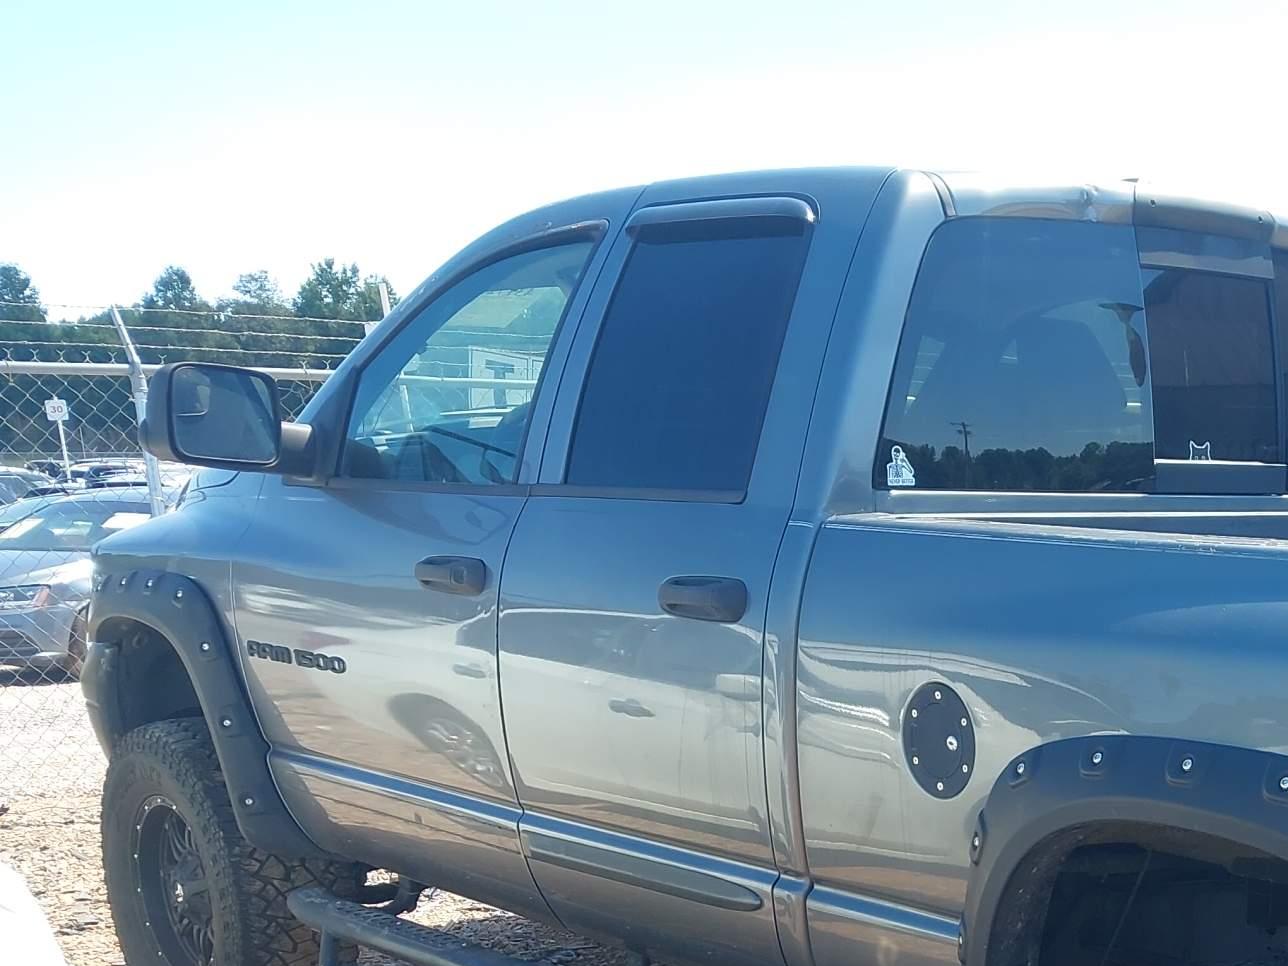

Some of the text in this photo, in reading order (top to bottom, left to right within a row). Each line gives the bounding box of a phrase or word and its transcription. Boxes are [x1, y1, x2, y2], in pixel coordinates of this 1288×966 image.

[49, 405, 64, 414] 30
[247, 640, 346, 674] RAM 1500
